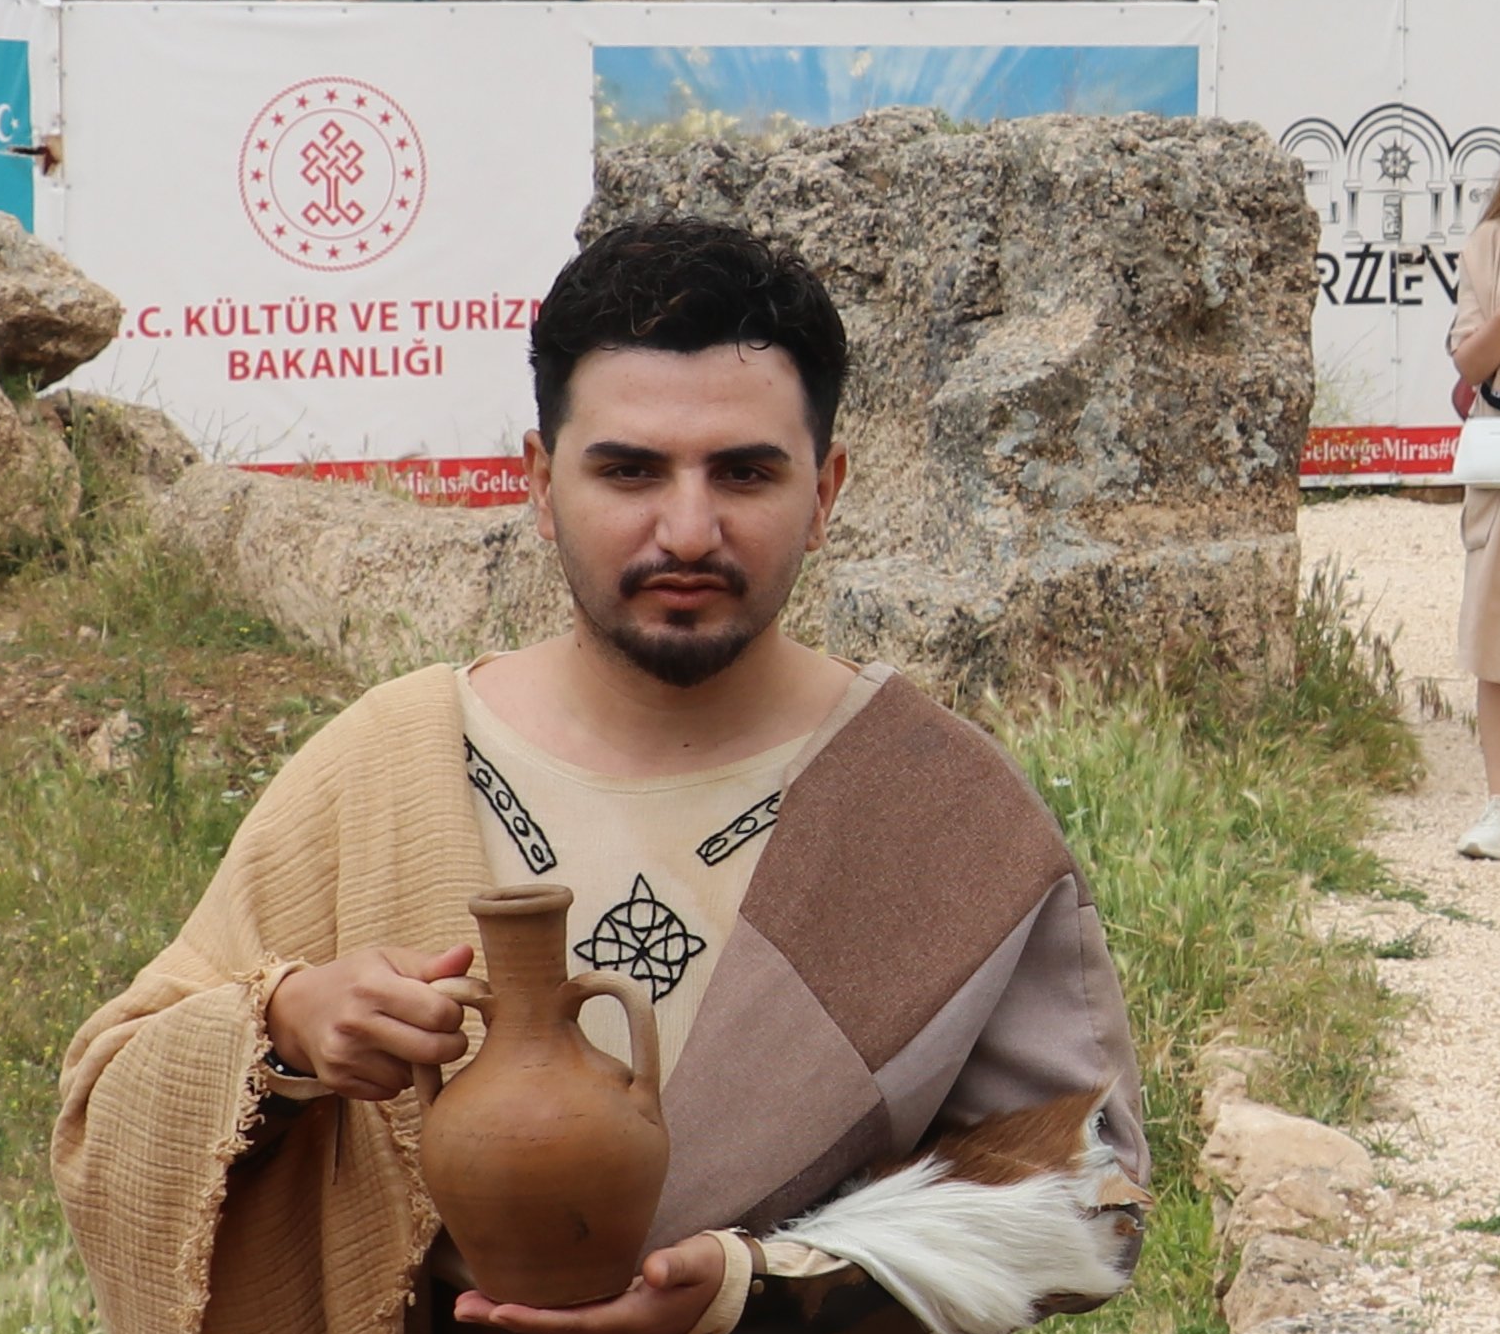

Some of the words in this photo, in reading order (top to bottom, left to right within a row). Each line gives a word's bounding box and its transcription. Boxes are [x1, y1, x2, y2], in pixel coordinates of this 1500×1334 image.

[116, 305, 172, 340] .C.
[184, 297, 337, 337] KÜLTÜR
[350, 300, 399, 333] VE
[227, 338, 444, 382] BAKANLIĞI
